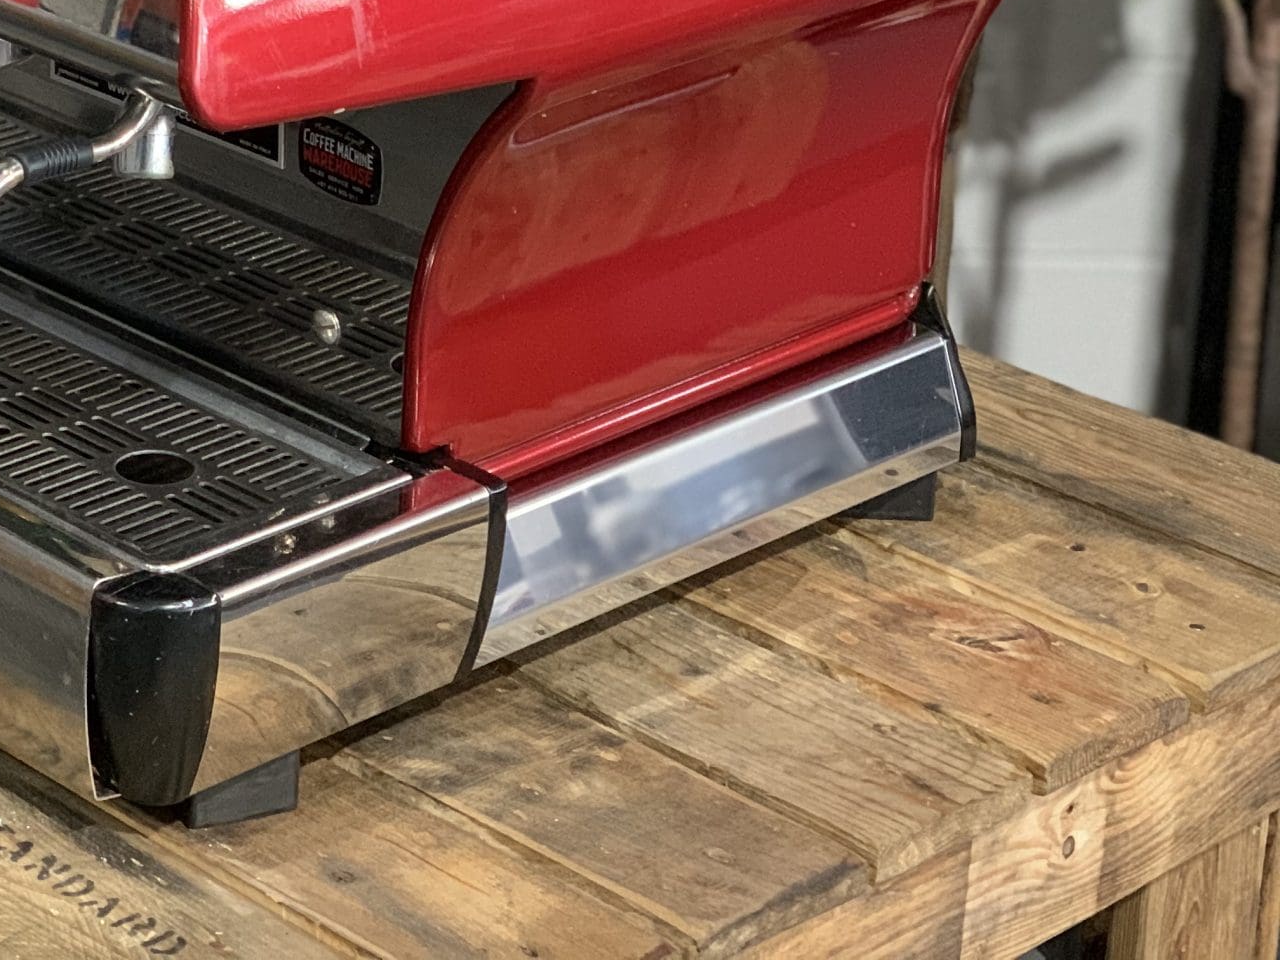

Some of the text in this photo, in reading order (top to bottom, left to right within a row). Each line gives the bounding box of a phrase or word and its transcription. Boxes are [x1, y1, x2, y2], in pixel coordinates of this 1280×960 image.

[303, 128, 336, 155] COFFEE
[336, 141, 374, 170] MACHINE
[303, 145, 374, 188] WAREHOUSE
